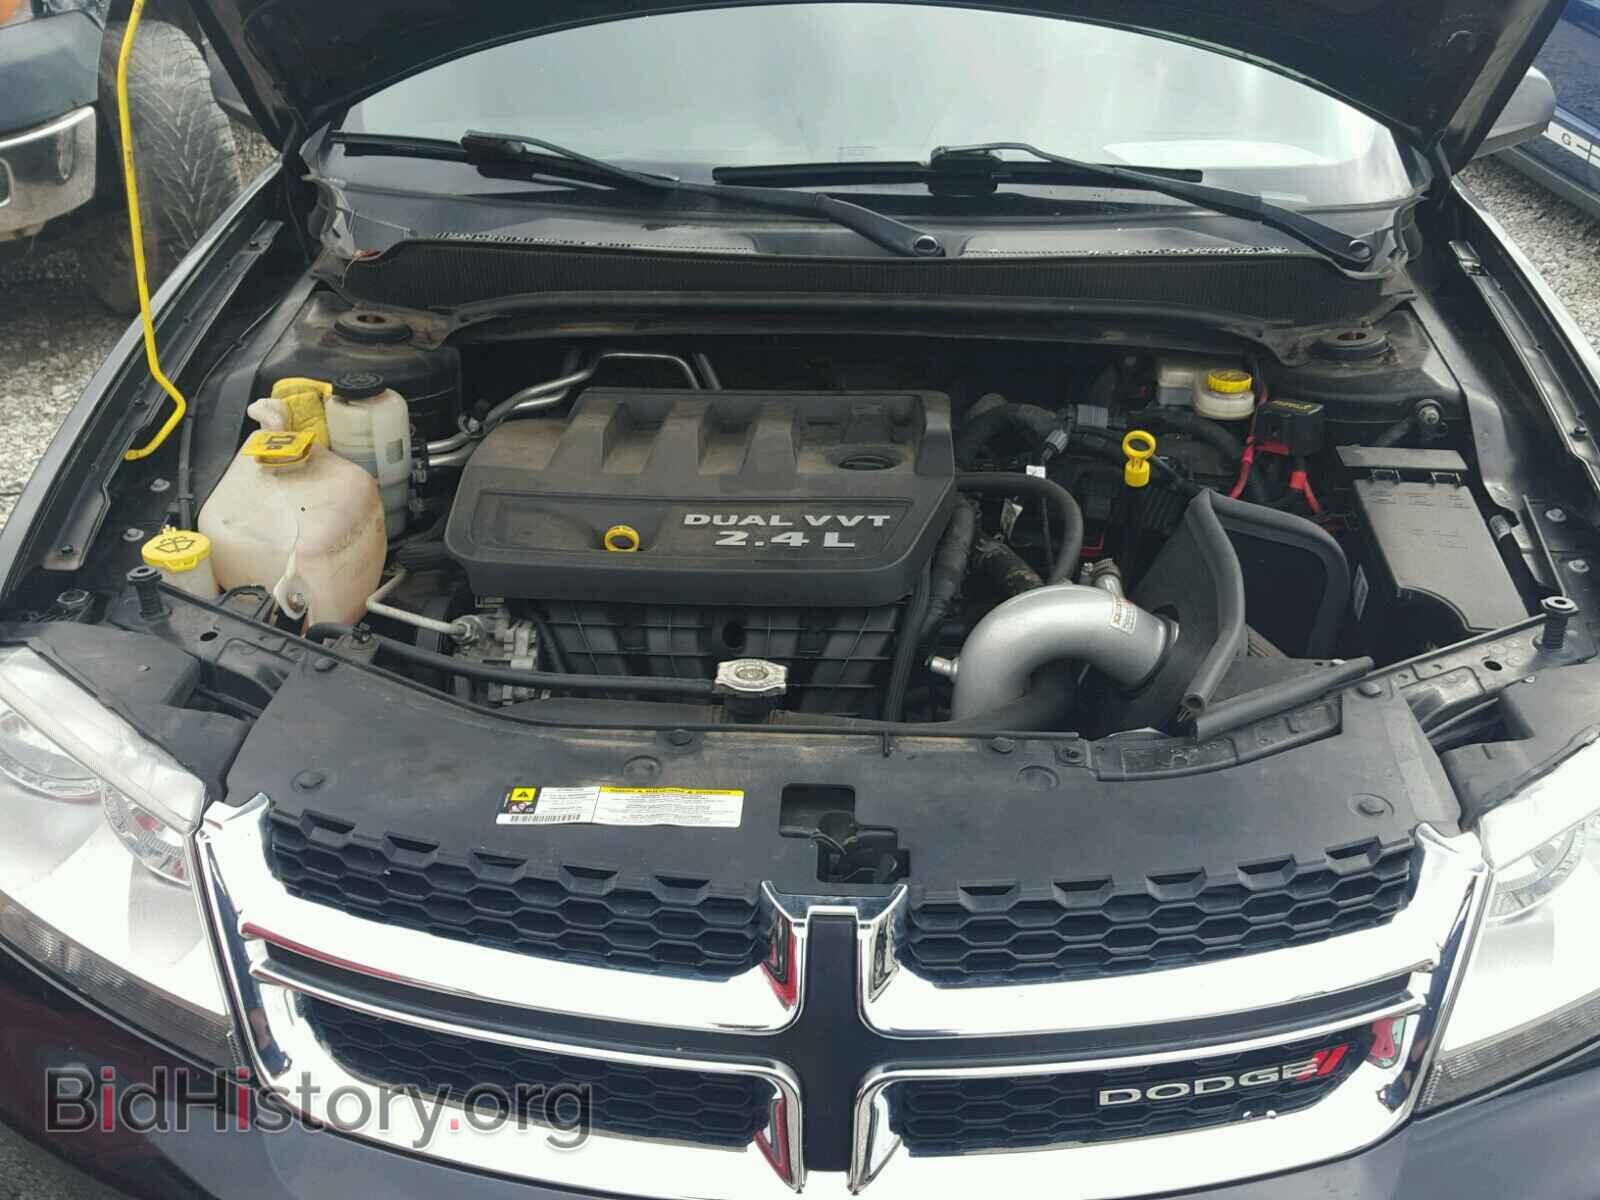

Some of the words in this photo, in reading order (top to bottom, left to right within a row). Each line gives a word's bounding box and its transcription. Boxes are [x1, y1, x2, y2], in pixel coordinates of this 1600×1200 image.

[684, 514, 792, 526] DUAL
[804, 515, 891, 527] VVT
[1099, 1057, 1319, 1106] DODGE
